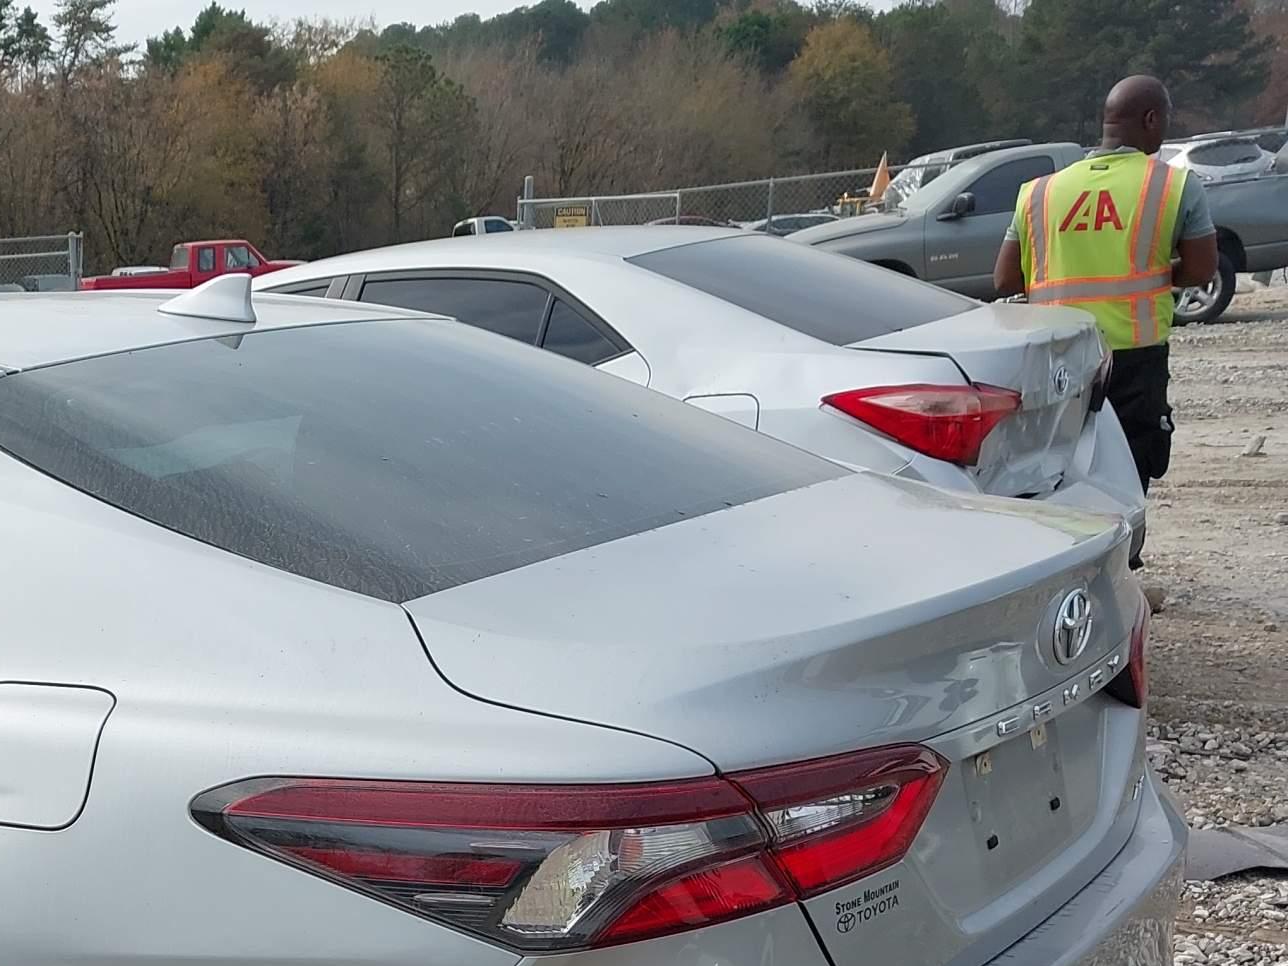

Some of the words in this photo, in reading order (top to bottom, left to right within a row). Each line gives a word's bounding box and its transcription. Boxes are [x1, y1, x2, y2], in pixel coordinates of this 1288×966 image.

[557, 207, 586, 216] CAUTION
[997, 655, 1120, 737] CAMRY
[856, 894, 900, 923] TOYOTA
